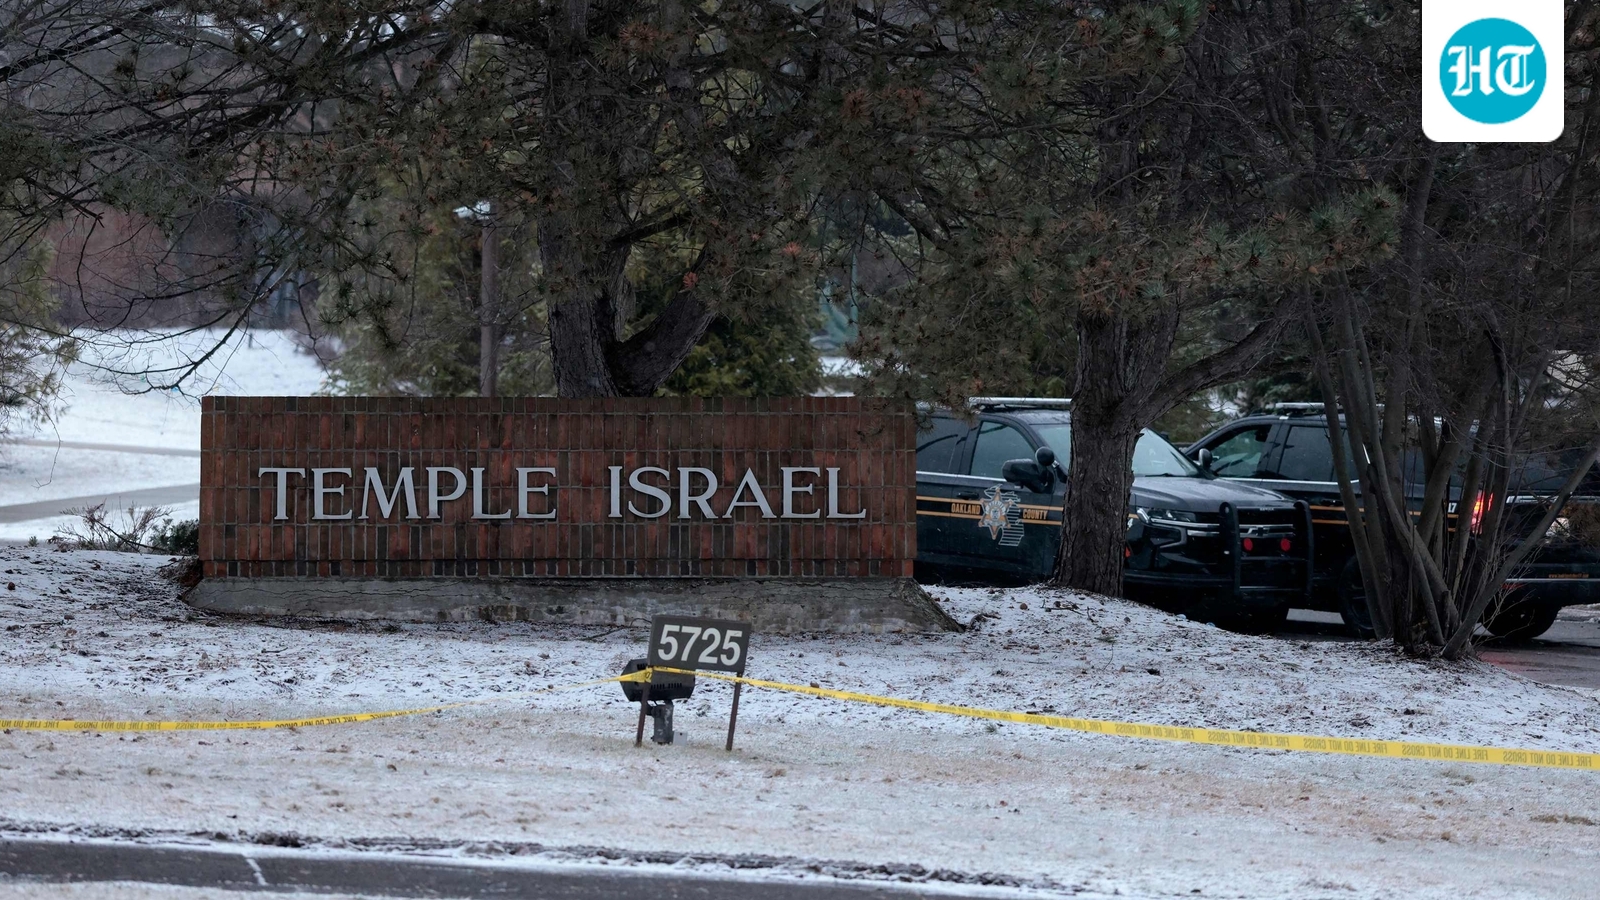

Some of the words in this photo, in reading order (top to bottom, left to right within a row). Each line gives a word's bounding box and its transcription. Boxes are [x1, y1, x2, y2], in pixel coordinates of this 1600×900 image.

[257, 465, 557, 521] TEMPLE
[607, 465, 867, 520] ISRAEL
[951, 503, 981, 515] OAKLAND
[1022, 508, 1048, 520] COUNTY
[657, 624, 743, 666] 5725
